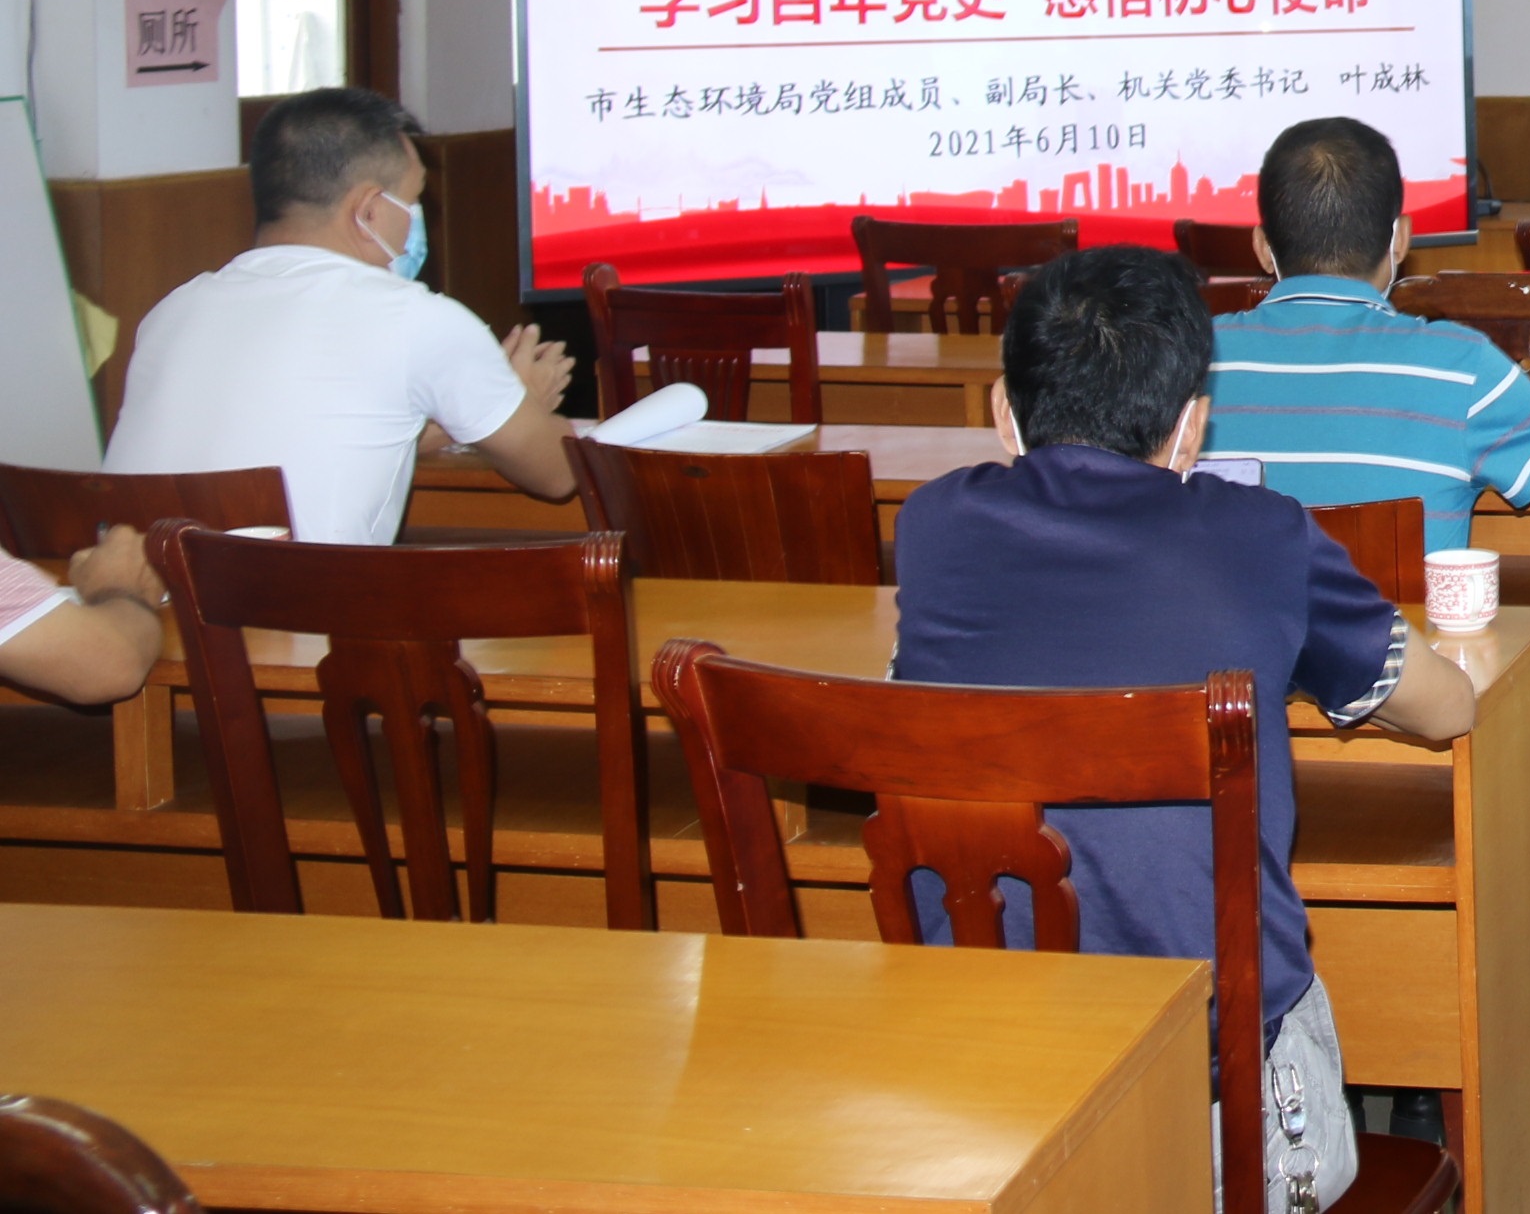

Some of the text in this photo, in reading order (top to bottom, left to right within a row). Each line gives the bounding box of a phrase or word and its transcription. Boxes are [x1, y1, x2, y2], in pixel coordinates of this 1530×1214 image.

[137, 7, 198, 56] 厕所
[585, 64, 1432, 122] 市生态环境局党组成员、副局长、机关党委书记 叶成林
[928, 122, 1150, 159] 2021年6月10日
